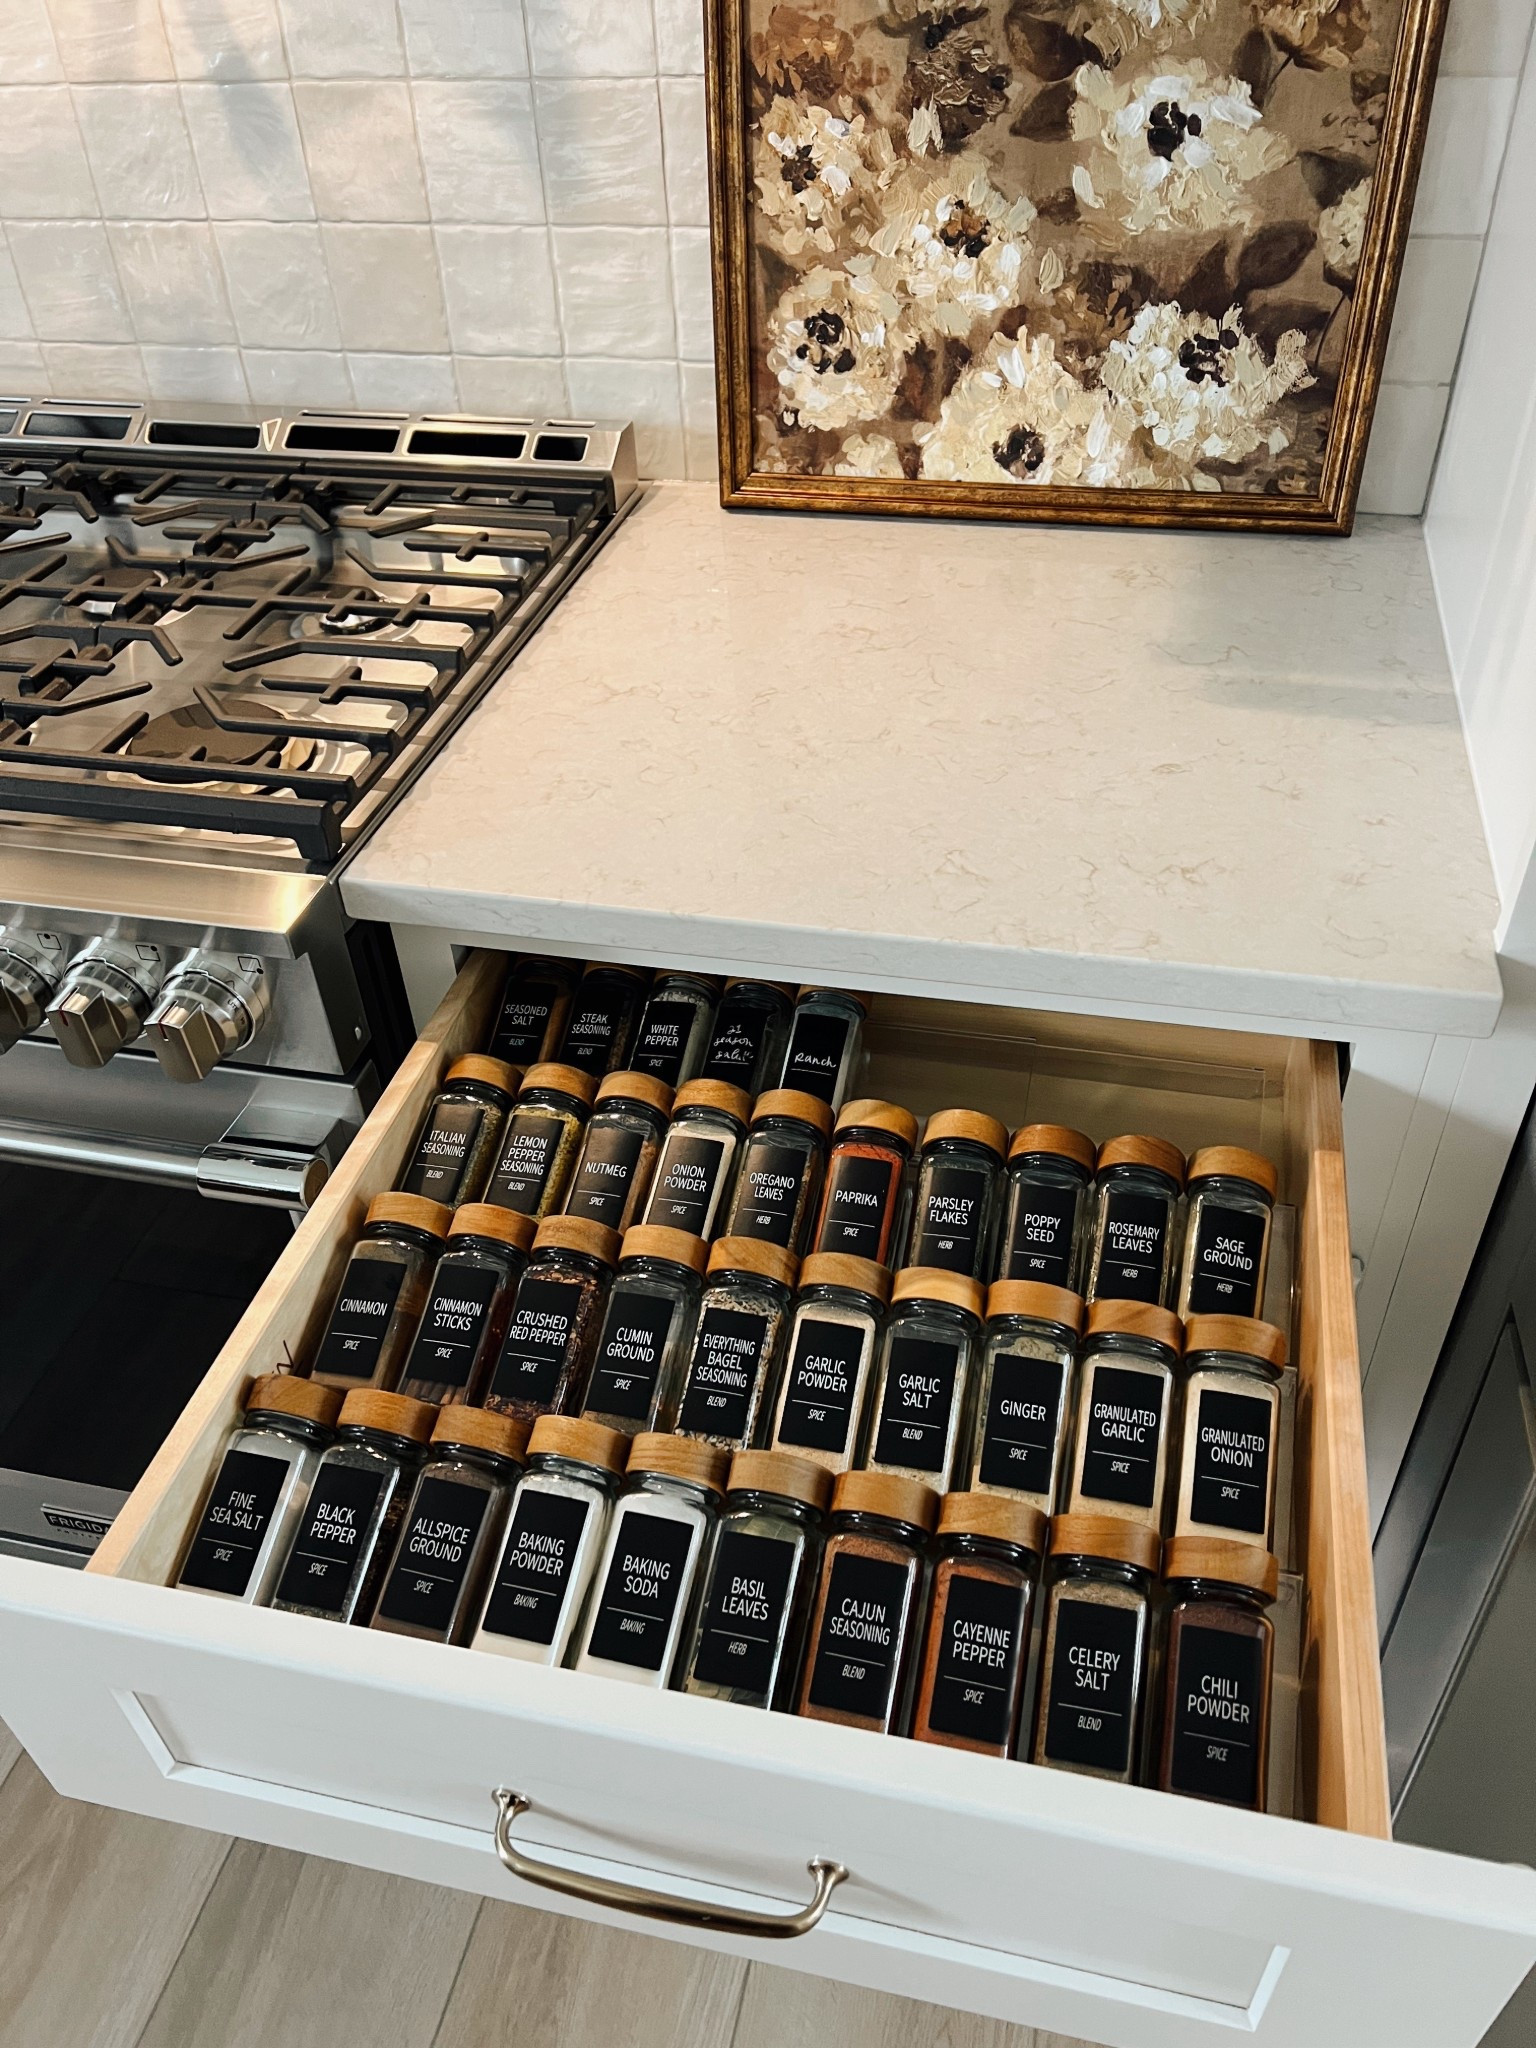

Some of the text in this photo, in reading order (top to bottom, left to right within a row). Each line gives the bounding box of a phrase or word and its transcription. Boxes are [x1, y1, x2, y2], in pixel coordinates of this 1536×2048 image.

[504, 1004, 548, 1017] SEASONED
[580, 1013, 609, 1024] STEAK
[511, 1014, 535, 1026] SALT
[571, 1023, 611, 1036] SEASONING
[651, 1024, 680, 1036] WHITE
[644, 1034, 679, 1047] PEPPER
[713, 1036, 753, 1047] season
[648, 1058, 664, 1067] SPICE
[794, 1052, 837, 1068] Ranch
[429, 1130, 467, 1145] ITALIAN
[513, 1135, 549, 1150] LEMON
[421, 1141, 466, 1158] SEASONING
[507, 1147, 546, 1163] PEPPER
[425, 1169, 444, 1179] BLEND
[500, 1159, 545, 1176] SEASONING
[584, 1161, 628, 1178] NUTMEG
[671, 1163, 706, 1179] ONION
[507, 1181, 526, 1191] BLEND
[663, 1175, 707, 1192] POWDER
[749, 1171, 795, 1189] OREGANO
[588, 1196, 605, 1206] SPICE
[753, 1185, 784, 1201] LEAVES
[834, 1189, 878, 1207] PAPRIKA
[670, 1204, 688, 1215] SPICE
[928, 1195, 974, 1212] PARSLEY
[755, 1215, 772, 1225] HERB
[929, 1209, 969, 1226] FLAKES
[1024, 1213, 1061, 1230] POPPY
[842, 1226, 860, 1237] SPICE
[1026, 1227, 1055, 1243] SEED
[1108, 1221, 1160, 1240] ROSEMARY
[937, 1240, 954, 1250] HERB
[1112, 1236, 1153, 1254] LEAVES
[1215, 1236, 1245, 1255] SAGE
[1029, 1258, 1047, 1269] SPICE
[1203, 1248, 1253, 1271] GROUND
[1122, 1268, 1139, 1279] HERB
[1216, 1282, 1234, 1294] HERB
[340, 1298, 388, 1316] CINNAMON
[433, 1297, 483, 1317] CINNAMON
[433, 1312, 473, 1331] STICKS
[516, 1309, 568, 1330] CRUSHED
[509, 1325, 567, 1347] RED PEPPER
[616, 1327, 653, 1346] CUMIN
[702, 1333, 756, 1356] EVERYTHING
[342, 1339, 361, 1351] SPICE
[434, 1347, 453, 1359] SPICE
[606, 1342, 655, 1363] GROUND
[520, 1361, 539, 1373] SPICE
[707, 1351, 743, 1371] BAGEL
[805, 1355, 846, 1375] GARLIC
[613, 1378, 632, 1391] SPICE
[695, 1365, 748, 1388] SEASONING
[797, 1370, 848, 1393] POWDER
[898, 1373, 941, 1394] GARLIC
[706, 1395, 727, 1408] BLEND
[902, 1390, 933, 1409] SALT
[807, 1408, 827, 1422] SPICE
[1000, 1399, 1047, 1422] GINGER
[1094, 1403, 1156, 1427] GRANULATED
[902, 1427, 923, 1441] BLEND
[1101, 1421, 1146, 1443] GARLIC
[1201, 1426, 1265, 1452] GRANULATED
[1008, 1447, 1029, 1461] SPICE
[1210, 1446, 1253, 1468] ONION
[1110, 1460, 1131, 1474] SPICE
[228, 1490, 257, 1510] FINE
[1220, 1486, 1241, 1500] SPICE
[209, 1506, 264, 1531] SEA SALT
[316, 1503, 356, 1525] BLACK
[309, 1521, 357, 1545] PEPPER
[412, 1517, 471, 1544] ALLSPICE
[409, 1537, 462, 1563] GROUND
[518, 1531, 565, 1556] BAKING
[212, 1548, 234, 1562] SPICE
[509, 1549, 564, 1577] POWDER
[308, 1562, 329, 1576] SPICE
[622, 1554, 671, 1580] BAKING
[413, 1579, 434, 1594] SPICE
[623, 1576, 658, 1599] SODA
[731, 1576, 766, 1600] BASIL
[513, 1593, 539, 1609] BAKING
[721, 1595, 769, 1621] LEAVES
[841, 1597, 886, 1624] CAJUN
[619, 1618, 646, 1635] BAKING
[829, 1616, 891, 1646] SEASONING
[953, 1619, 1011, 1649] CAYENNE
[727, 1641, 748, 1656] HERB
[952, 1640, 1006, 1669] PEPPER
[1068, 1646, 1121, 1672] CELERY
[841, 1664, 866, 1680] BLEND
[1075, 1668, 1110, 1691] SALT
[1201, 1674, 1238, 1700] CHILI
[963, 1688, 985, 1705] SPICE
[1187, 1694, 1250, 1724] POWDER
[1077, 1715, 1102, 1731] BLEND
[1206, 1745, 1229, 1762] SPICE
